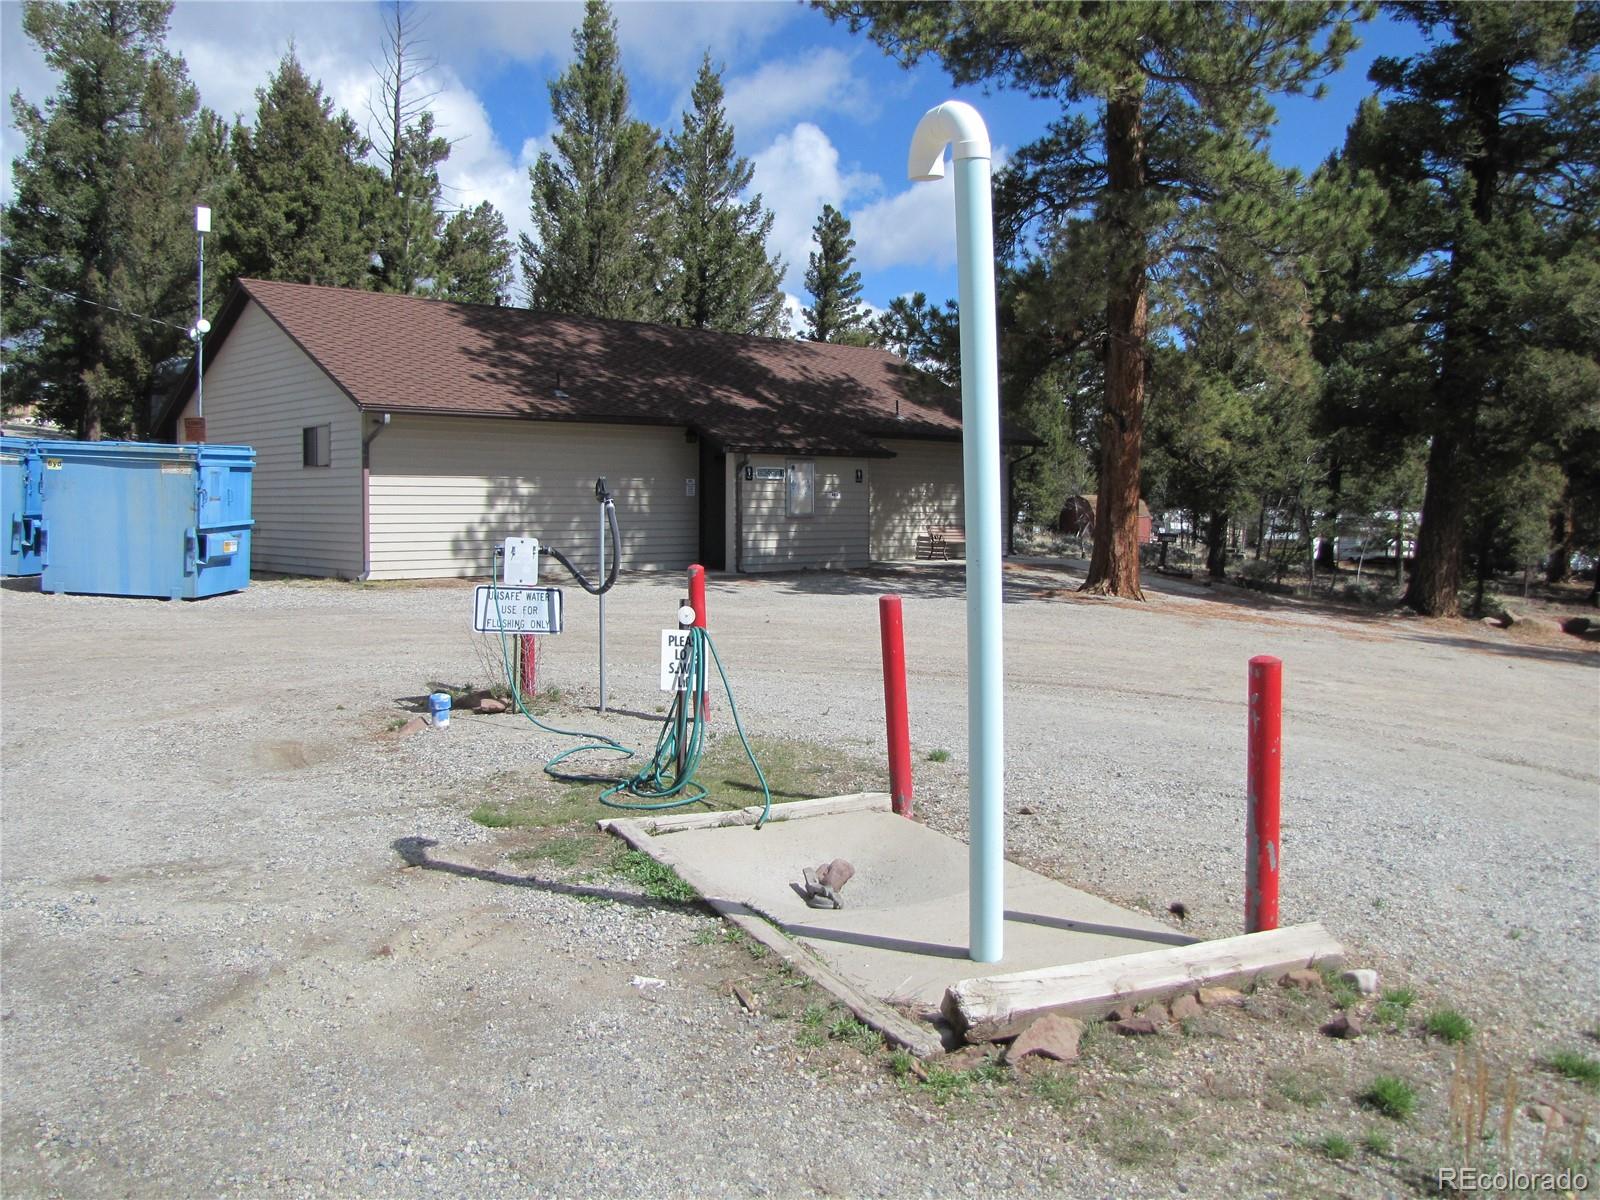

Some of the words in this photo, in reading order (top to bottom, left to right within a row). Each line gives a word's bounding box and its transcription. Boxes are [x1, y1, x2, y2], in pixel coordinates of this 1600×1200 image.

[526, 593, 551, 601] WATER
[501, 605, 516, 615] USE
[522, 606, 538, 615] FOR
[530, 619, 552, 629] ONLY
[668, 635, 695, 647] PLEA
